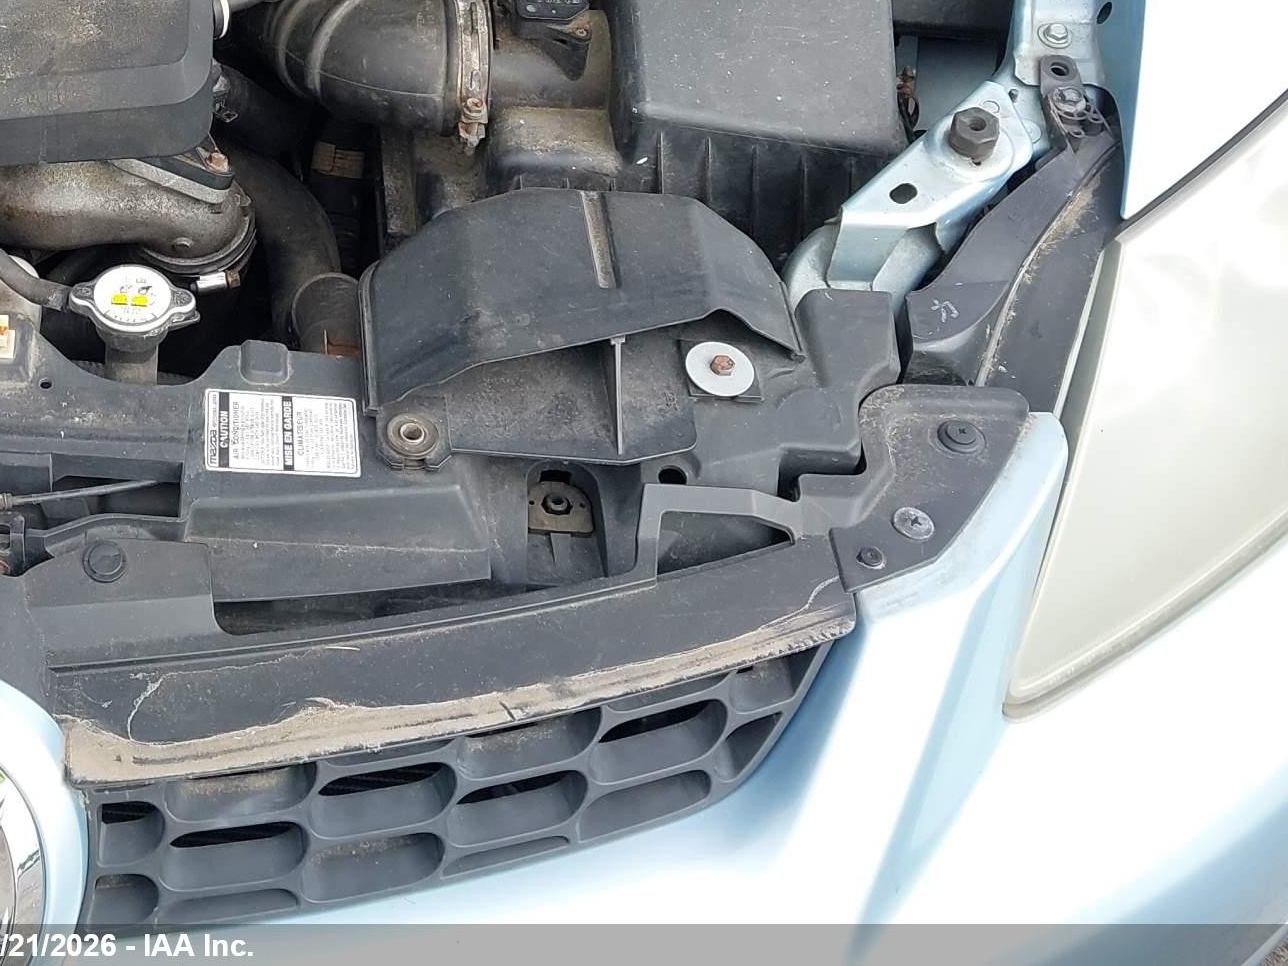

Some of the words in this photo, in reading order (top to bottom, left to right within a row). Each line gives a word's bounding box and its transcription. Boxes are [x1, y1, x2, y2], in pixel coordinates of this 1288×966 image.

[219, 410, 229, 448] CAUTION
[232, 401, 240, 444] CONDITIONER
[282, 401, 293, 429] GARDE
[209, 429, 218, 464] mazda
[283, 430, 293, 443] EN
[283, 444, 294, 466] MISE
